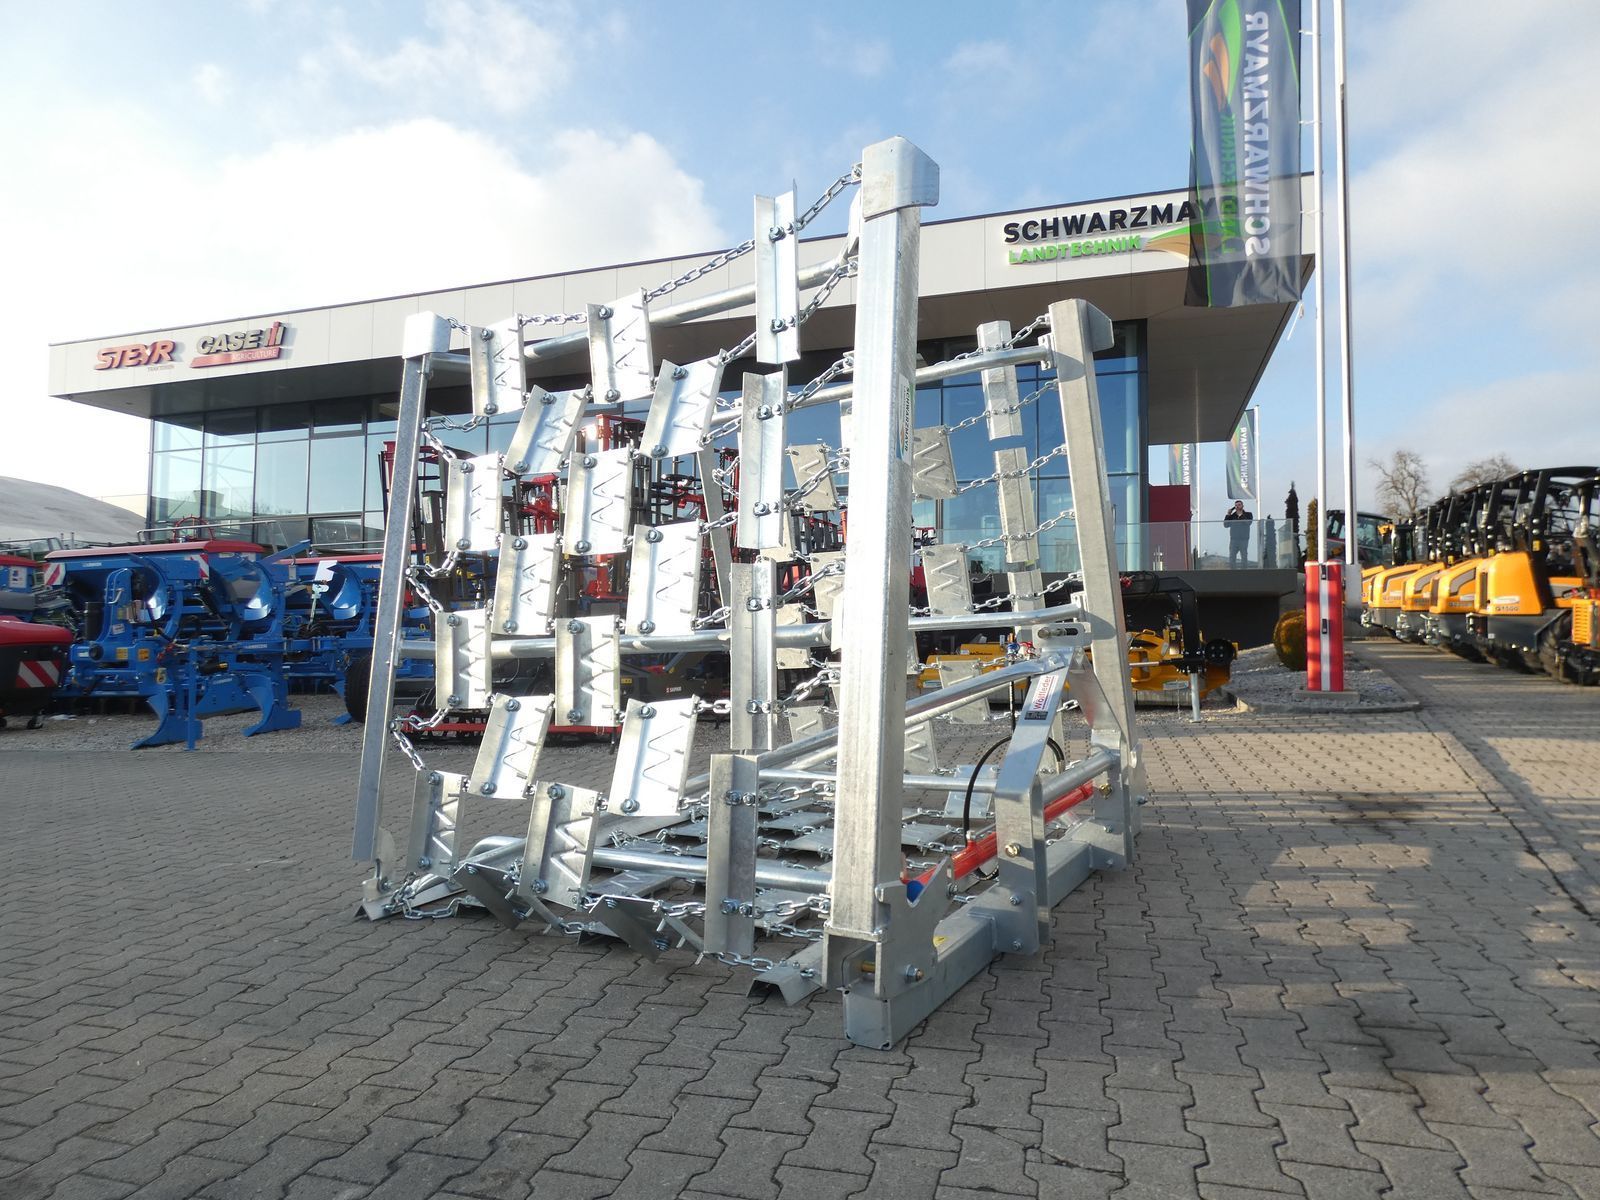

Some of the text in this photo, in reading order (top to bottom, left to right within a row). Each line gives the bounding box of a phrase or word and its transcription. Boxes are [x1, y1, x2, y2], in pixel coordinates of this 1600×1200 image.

[1003, 196, 1237, 243] SCHWARZMAY
[1009, 234, 1143, 264] LANDTECHNIK
[95, 340, 176, 371] STEYR
[196, 328, 263, 355] CASE
